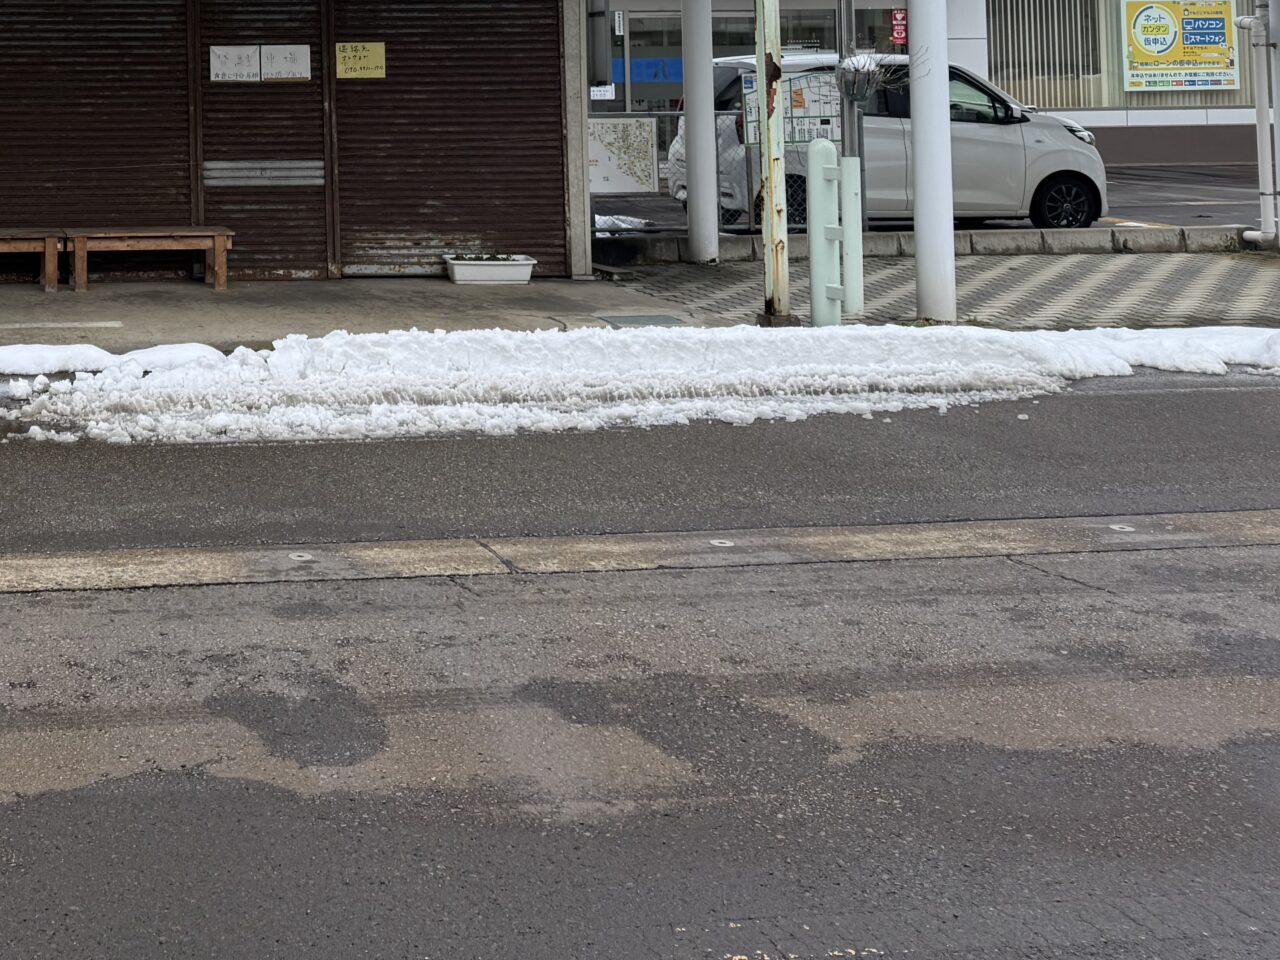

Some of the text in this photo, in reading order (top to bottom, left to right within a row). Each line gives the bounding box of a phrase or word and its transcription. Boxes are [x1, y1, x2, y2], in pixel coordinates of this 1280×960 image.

[1144, 14, 1166, 23] ネット
[1142, 25, 1168, 33] カンタン
[1195, 20, 1223, 29] パソコン
[1144, 37, 1168, 46] 仮申込
[1190, 34, 1225, 43] スマートフォン
